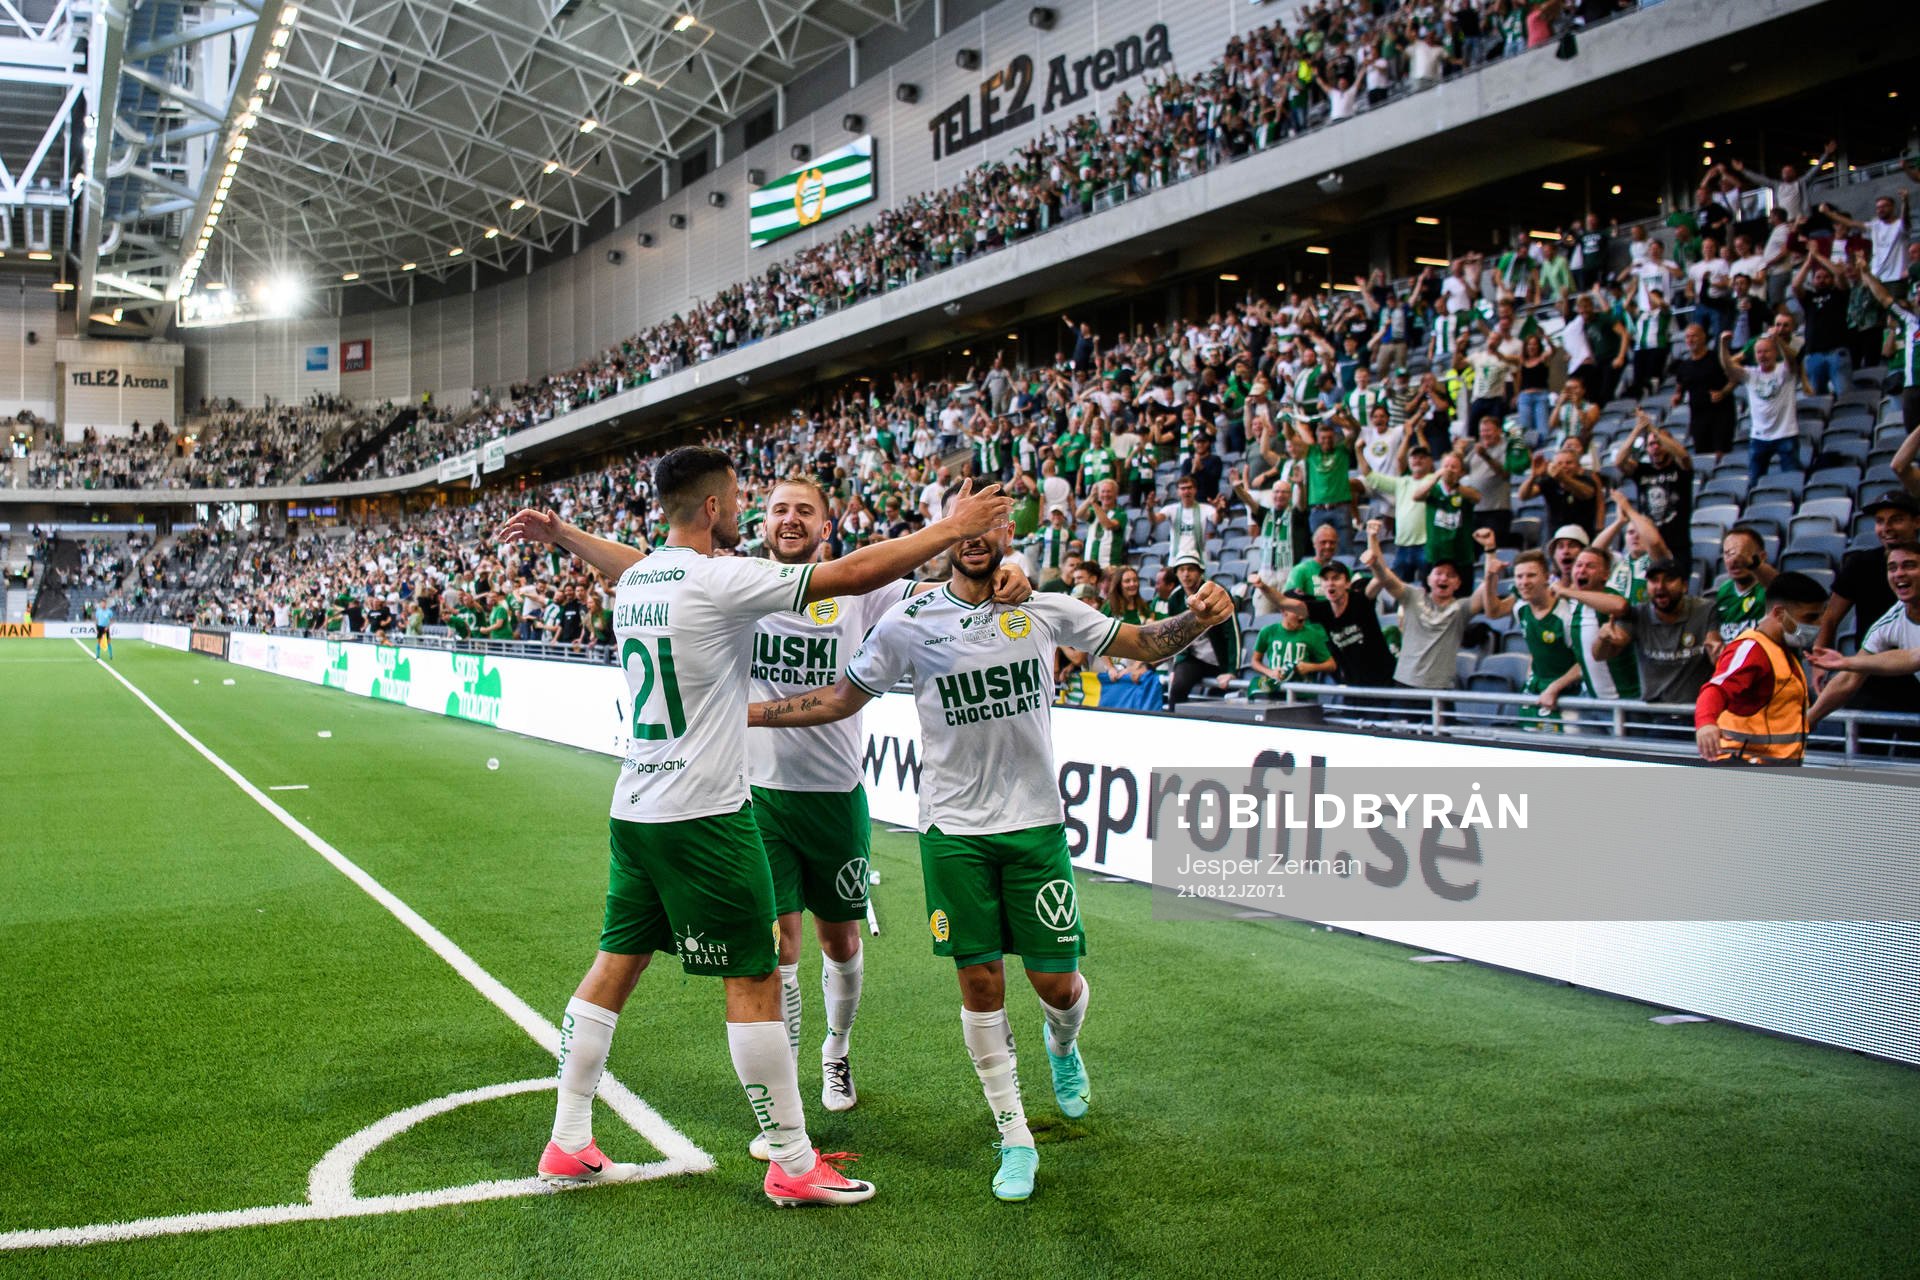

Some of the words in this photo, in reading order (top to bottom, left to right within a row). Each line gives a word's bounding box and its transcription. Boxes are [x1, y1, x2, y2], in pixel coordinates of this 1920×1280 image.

[929, 53, 1035, 161] TELE2
[1042, 23, 1173, 115] Arena
[71, 369, 119, 386] TELE2
[122, 374, 169, 389] Arena
[626, 567, 686, 586] limitado
[904, 591, 936, 618] BST
[70, 626, 97, 635] CRA
[924, 636, 950, 646] CRAFT
[750, 662, 837, 687] HOCOLATE
[935, 658, 1041, 709] HUSKI
[622, 637, 687, 741] 21
[945, 692, 1041, 727] CHOCOLATE
[1058, 749, 1484, 903] gprofil.se
[679, 951, 729, 966] STRÅLE
